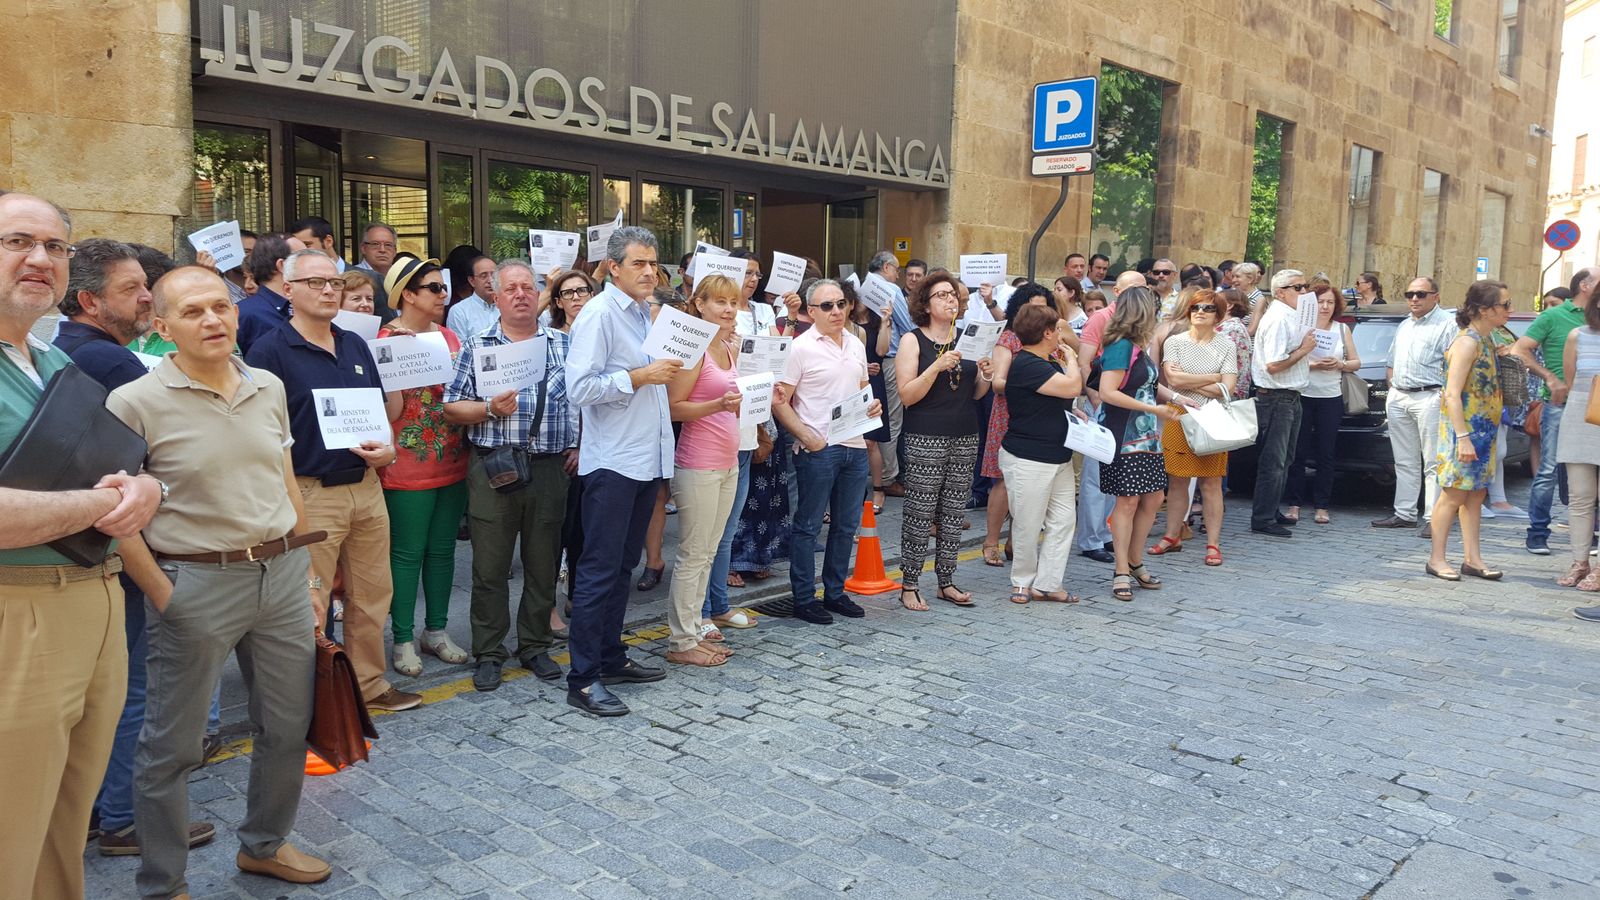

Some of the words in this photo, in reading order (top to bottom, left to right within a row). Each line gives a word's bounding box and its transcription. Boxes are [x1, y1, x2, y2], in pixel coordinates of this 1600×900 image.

[205, 5, 607, 132] JUZGADOS
[630, 86, 693, 146] DE
[711, 102, 948, 183] SALAMANCA
[1045, 89, 1082, 142] P
[1057, 132, 1087, 141] JUZGADOS
[1046, 156, 1077, 164] RESERVADO
[1047, 163, 1075, 171] JUZGADOS
[716, 264, 742, 272] QUEREMOS
[670, 319, 682, 329] NO
[682, 324, 710, 339] QUEREMOS
[670, 334, 700, 350] JUZGADOS
[397, 351, 432, 362] MINISTRO
[409, 364, 443, 375] ENGAÑAR
[501, 359, 532, 370] MINISTRO
[340, 408, 371, 416] MINISTRO
[326, 426, 343, 434] DEJA
[351, 423, 383, 433] ENGAÑAR
